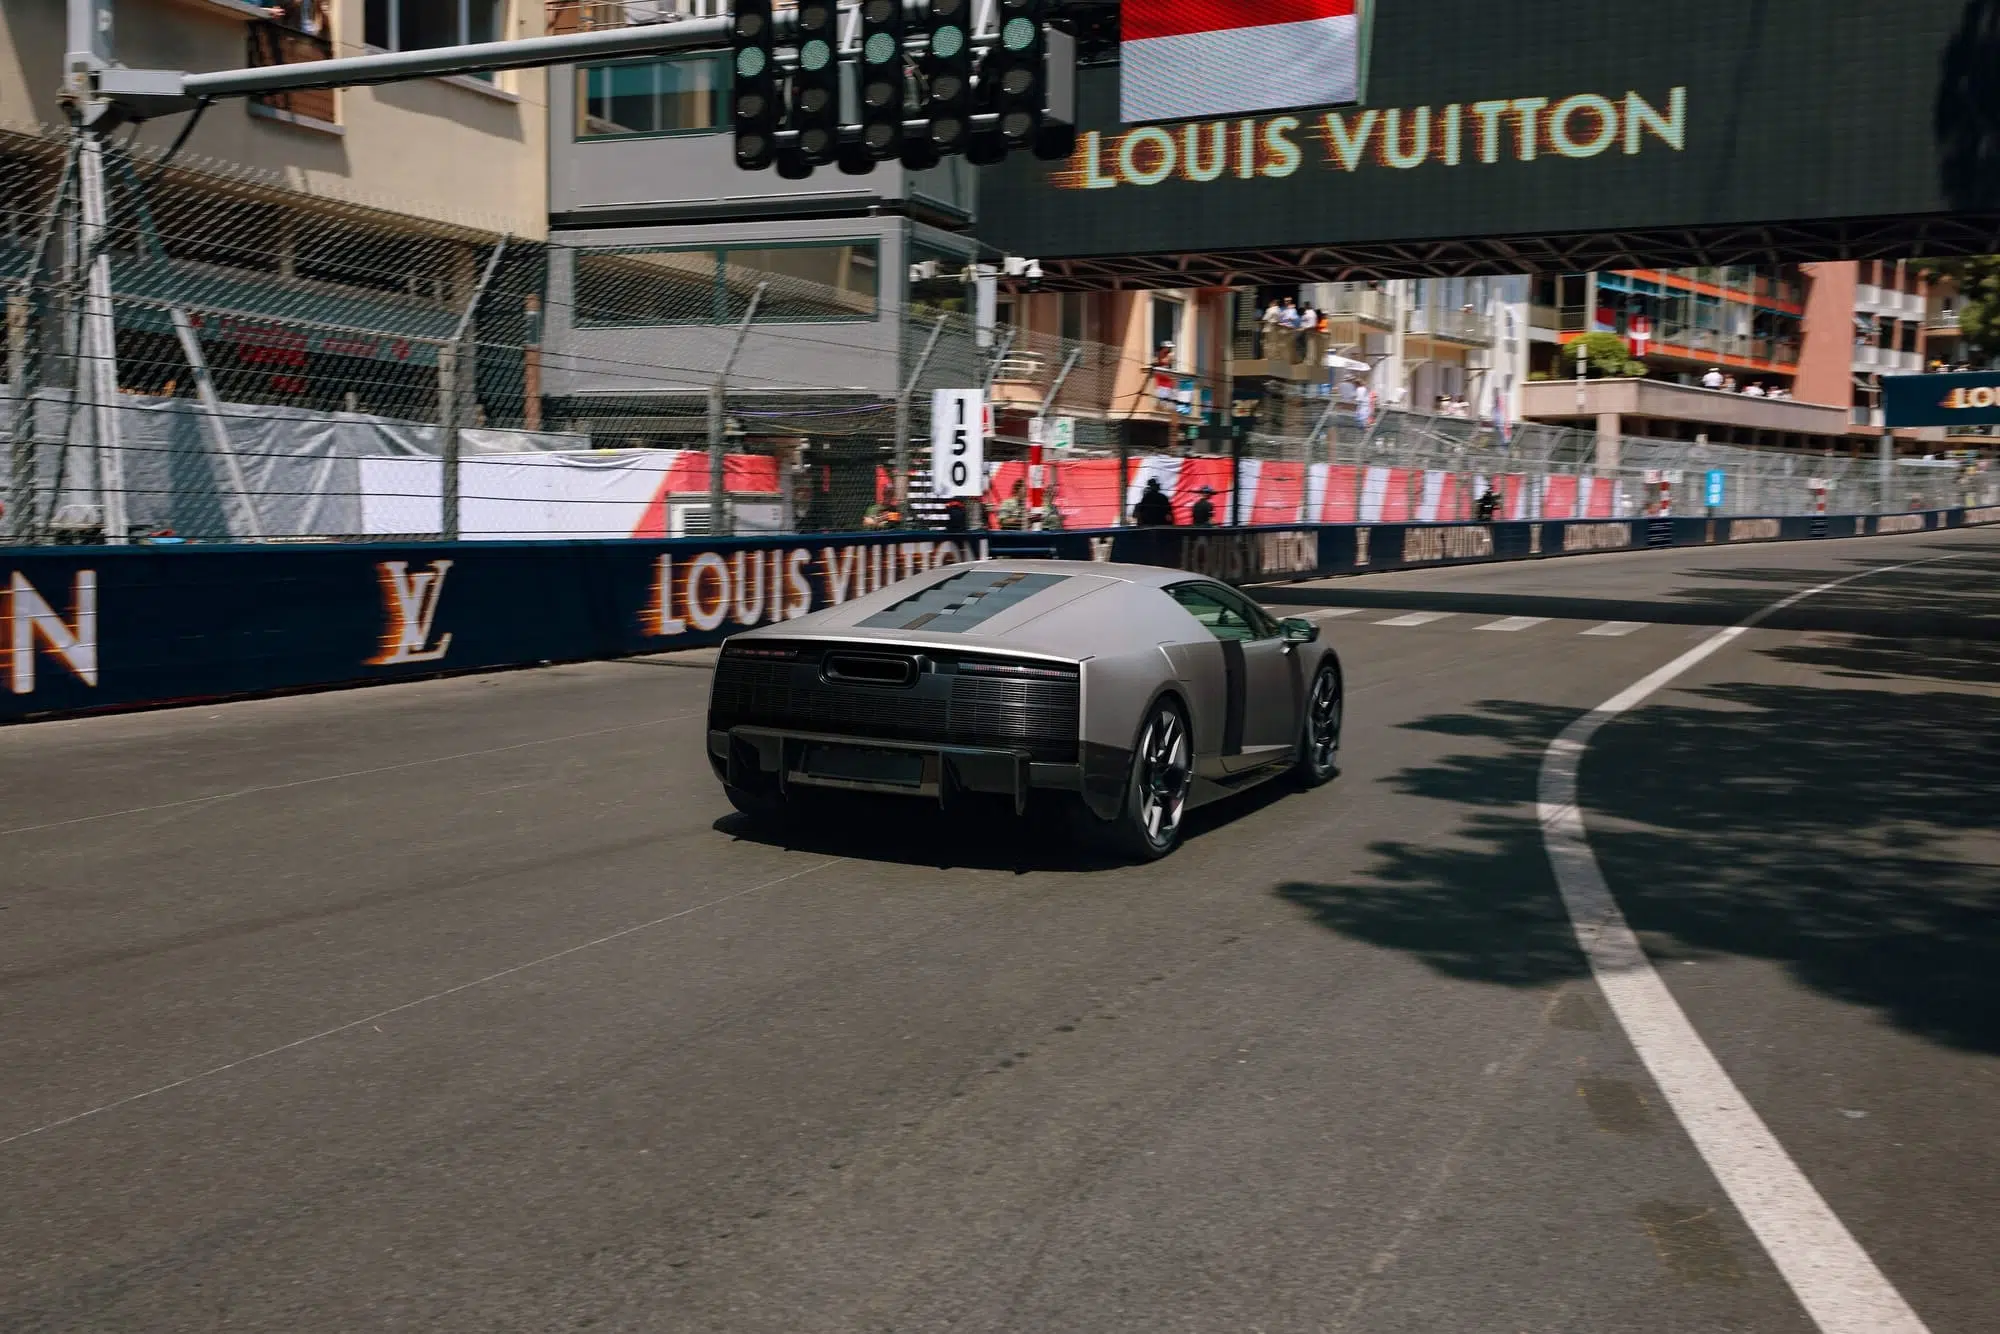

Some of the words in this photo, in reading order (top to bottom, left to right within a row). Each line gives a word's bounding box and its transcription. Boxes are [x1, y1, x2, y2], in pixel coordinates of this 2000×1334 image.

[1072, 117, 1301, 190] LOUIS
[1325, 86, 1684, 172] VUITTON
[1948, 386, 2000, 409] LO
[952, 398, 966, 486] 150
[652, 548, 812, 634] LOUIS
